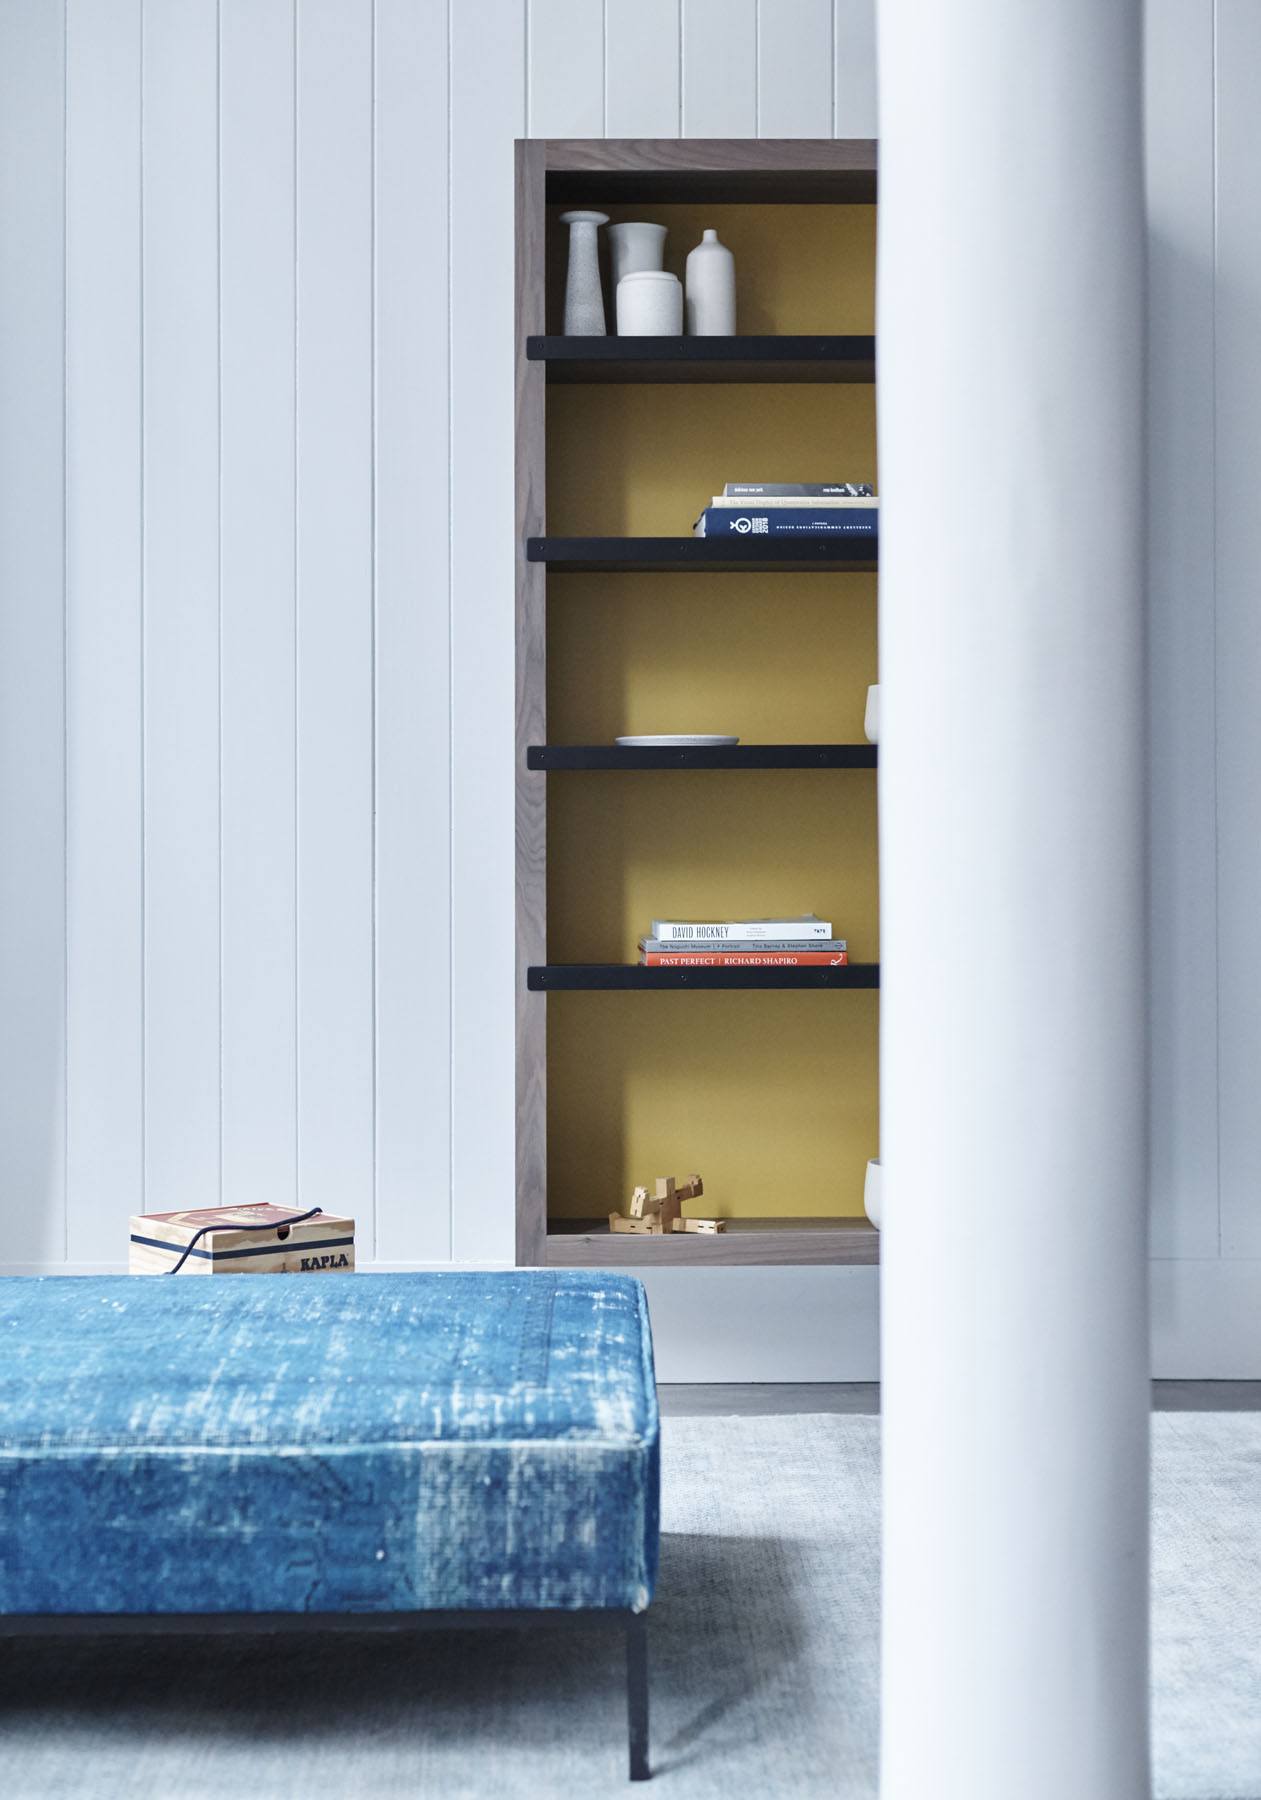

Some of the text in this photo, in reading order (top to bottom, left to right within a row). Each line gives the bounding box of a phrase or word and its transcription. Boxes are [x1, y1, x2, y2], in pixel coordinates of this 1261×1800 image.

[672, 926, 729, 939] DAVID HOCKNEY
[660, 957, 798, 965] PAST PERFECT RICHARD SHAPIRO
[300, 1253, 349, 1272] KAPLA
